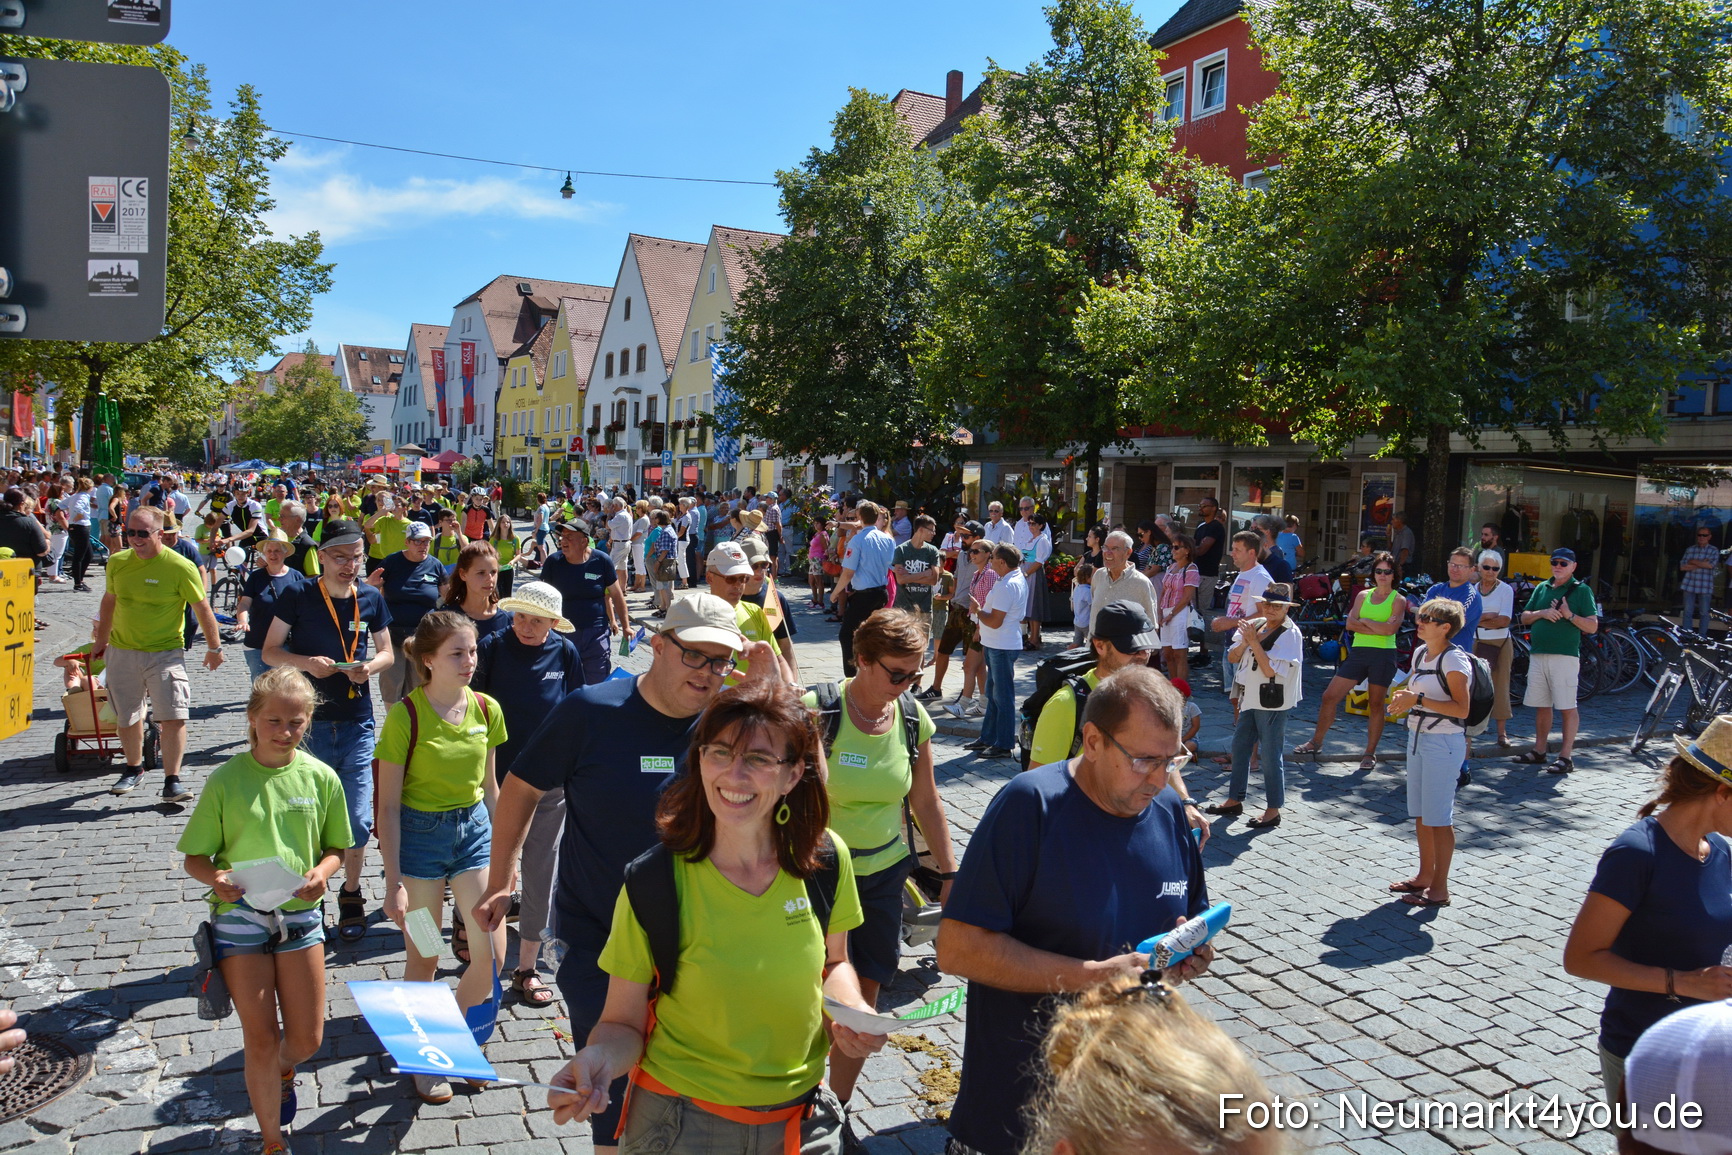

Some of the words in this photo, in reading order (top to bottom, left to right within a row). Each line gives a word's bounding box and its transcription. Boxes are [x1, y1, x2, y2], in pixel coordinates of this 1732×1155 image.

[93, 186, 114, 196] RAL
[122, 207, 146, 216] 2017
[463, 345, 471, 365] K&L
[663, 453, 671, 465] P
[5, 600, 15, 635] S
[18, 611, 32, 635] 100
[4, 642, 24, 675] T
[21, 653, 32, 677] 77
[9, 695, 20, 720] 81
